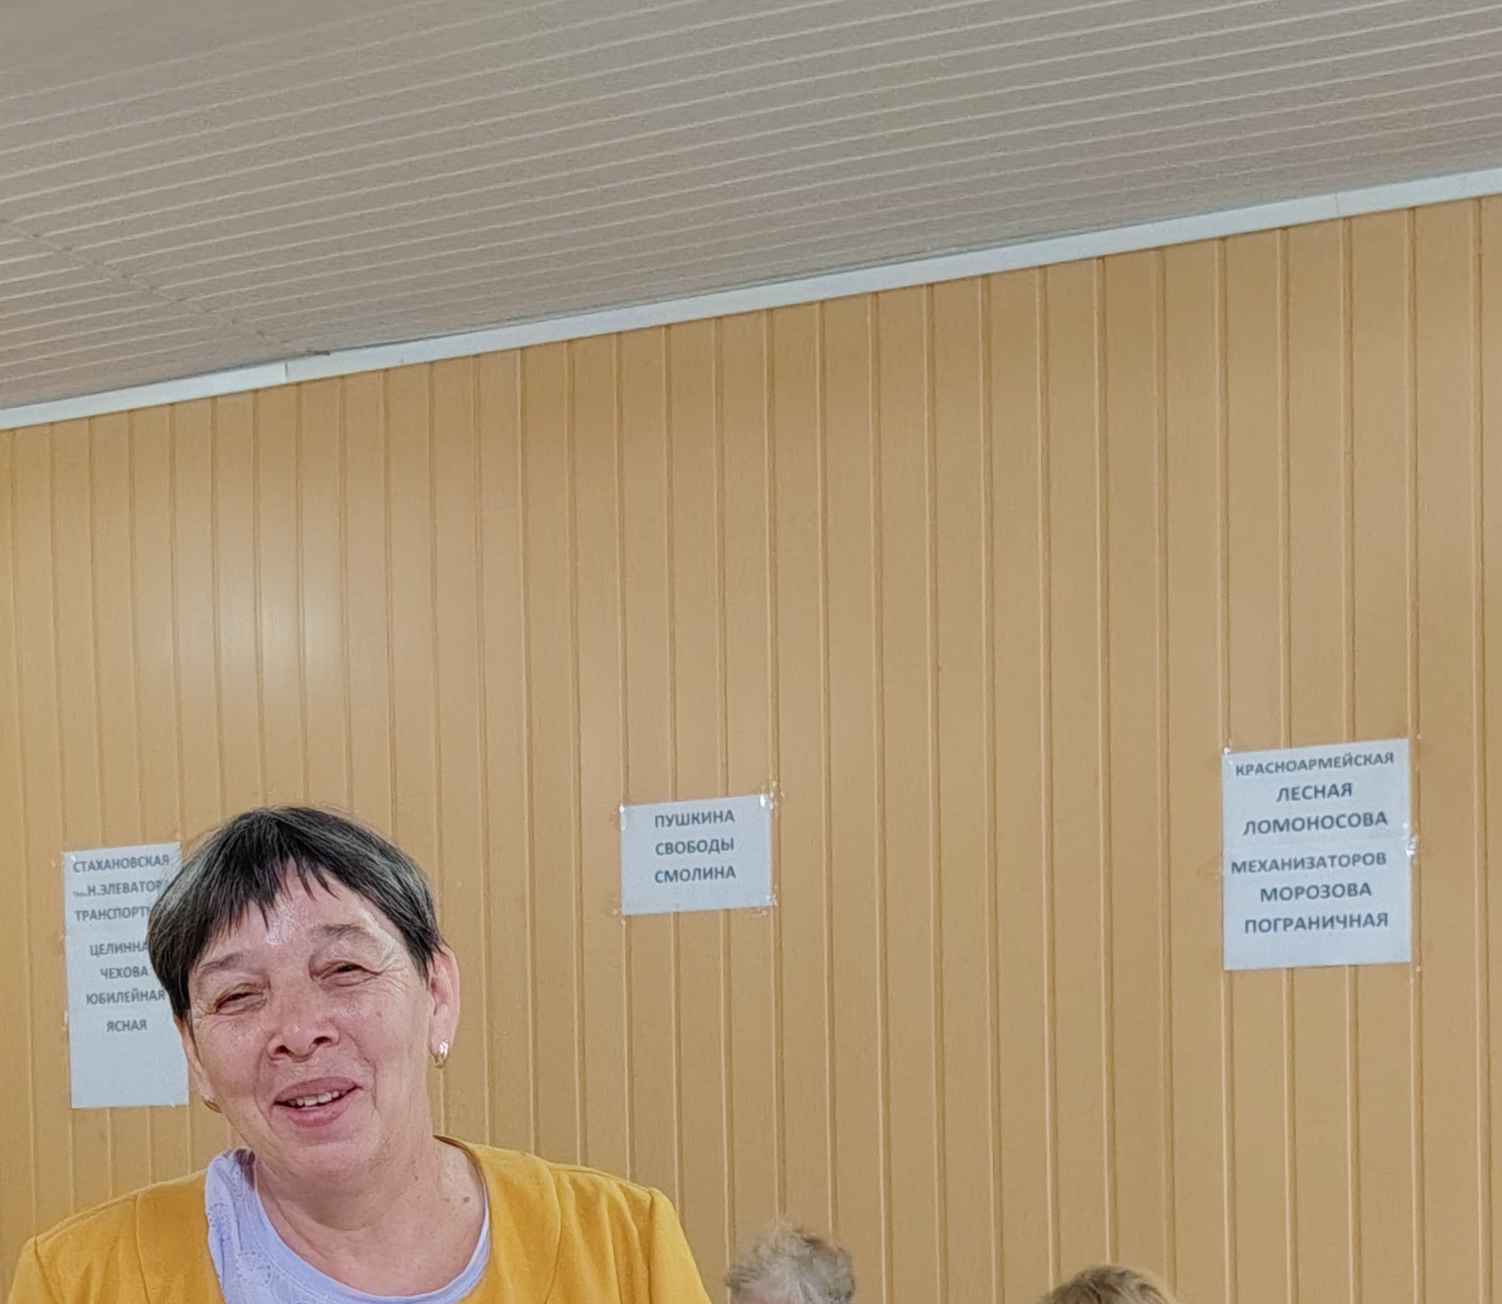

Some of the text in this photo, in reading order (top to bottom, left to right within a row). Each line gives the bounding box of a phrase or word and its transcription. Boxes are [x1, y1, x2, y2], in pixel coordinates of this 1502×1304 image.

[1235, 751, 1395, 777] КРАСНОАРМЕЙСКАЯ
[1276, 782, 1354, 803] ЛЕСНАЯ
[654, 809, 736, 828] ПУШКИНА
[1242, 811, 1389, 836] ЛОМОНОСОВА
[655, 837, 735, 856] СВОБОДЫ
[72, 854, 170, 873] СТАХАНОВСКАЯ
[1231, 852, 1388, 875] МЕХАНИЗАТОРОВ
[654, 865, 737, 884] СМОЛИНА
[1259, 882, 1373, 903] МОРОЗОВА
[1244, 911, 1389, 935] ПОГРАНИЧНАЯ
[89, 940, 148, 957] ЦЕЛИННА
[100, 965, 149, 980] ЧЕХОВА
[85, 988, 166, 1006] ЮБИЛЕЙНАЯ
[106, 1018, 148, 1033] ЯСНАЯ
